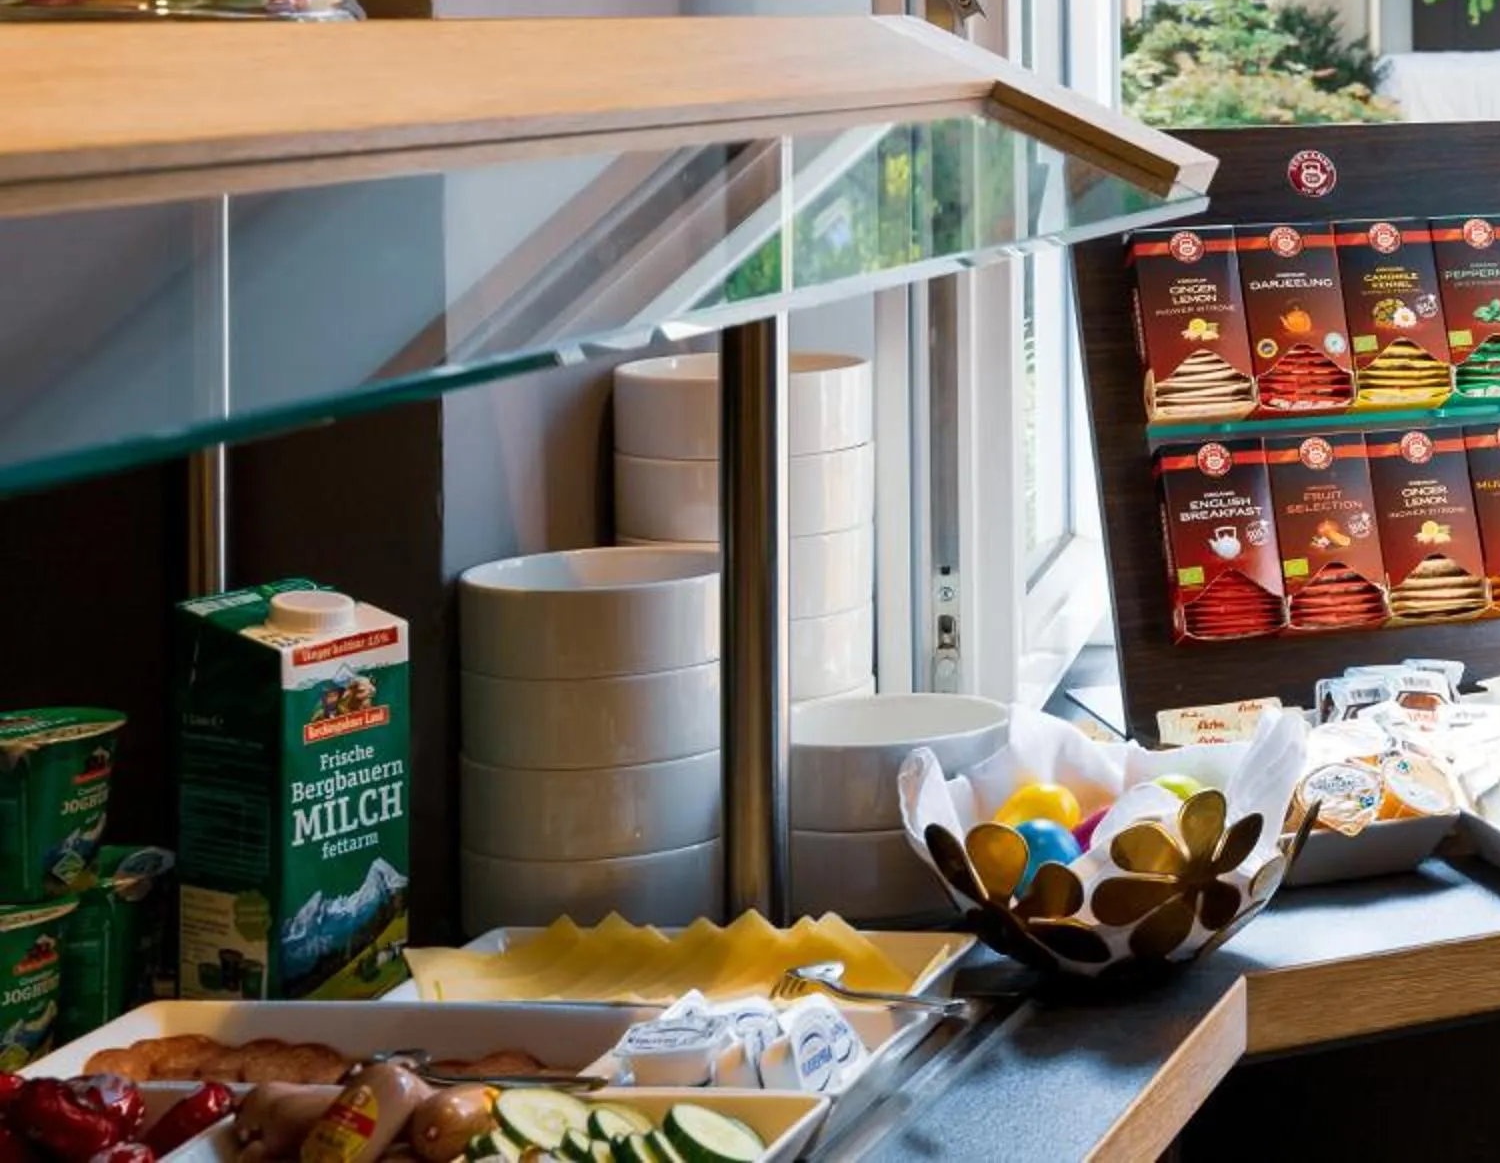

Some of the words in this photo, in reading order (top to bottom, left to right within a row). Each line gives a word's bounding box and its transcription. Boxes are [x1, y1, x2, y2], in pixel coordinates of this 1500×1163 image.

[1169, 284, 1217, 295] GINGER
[1250, 278, 1333, 290] DARJEELING
[1172, 294, 1217, 305] LEMON
[1303, 490, 1342, 502] FRUIT
[1401, 485, 1448, 498] GINGER
[1189, 497, 1251, 510] ENGLISH
[1286, 501, 1363, 514] SELECTION
[1405, 496, 1448, 507] LEMON
[1179, 506, 1263, 522] BREAKFAST
[320, 744, 375, 771] Frische
[291, 760, 404, 804] Bergbauern
[291, 781, 403, 847] MILCH
[321, 831, 378, 860] fettarm
